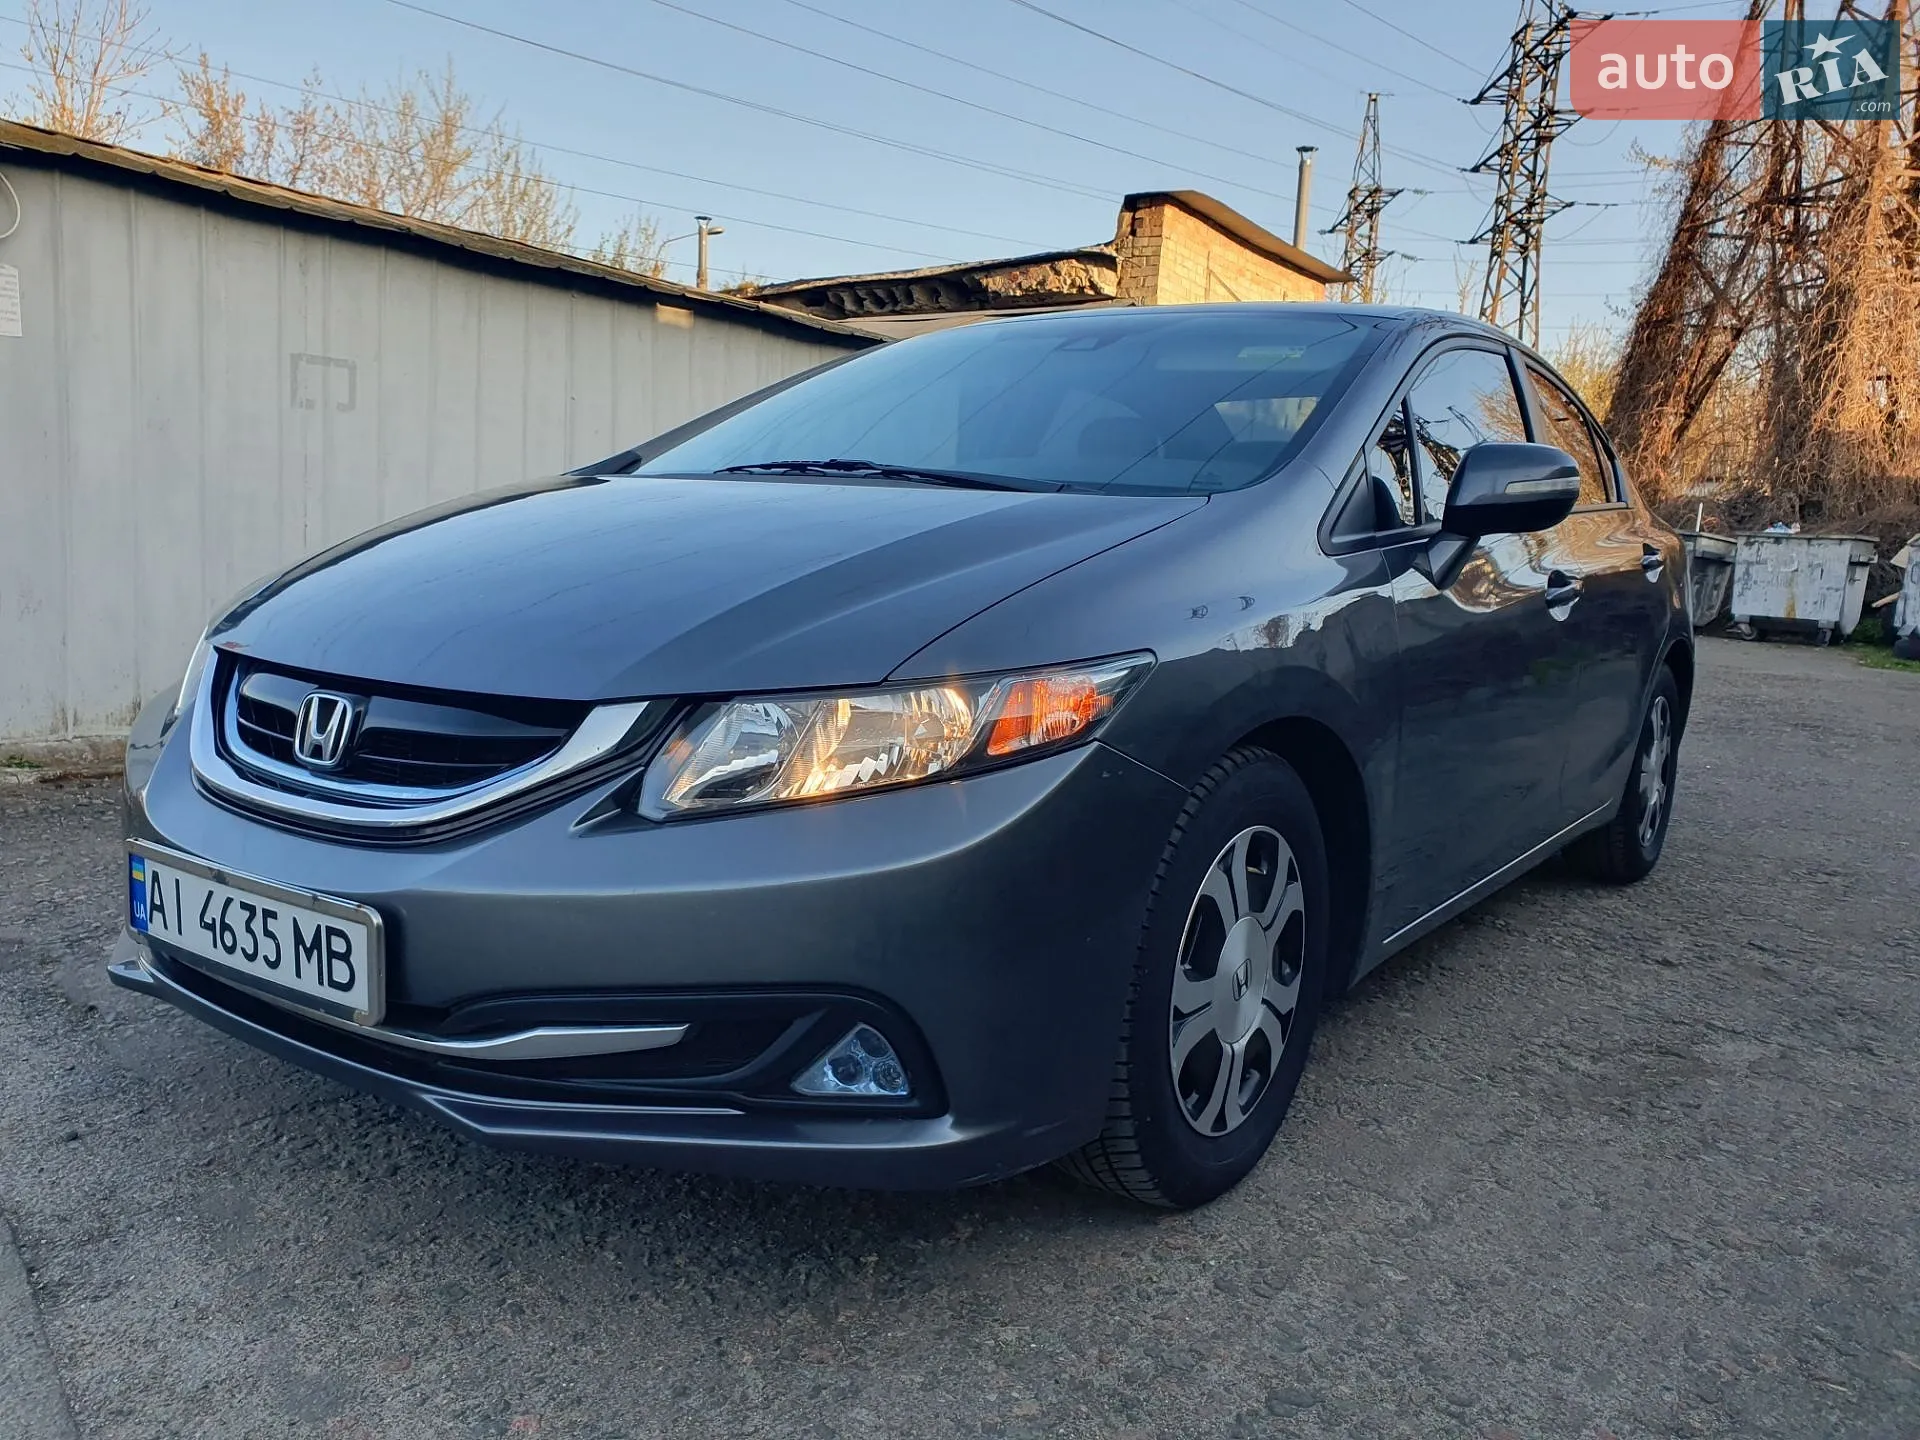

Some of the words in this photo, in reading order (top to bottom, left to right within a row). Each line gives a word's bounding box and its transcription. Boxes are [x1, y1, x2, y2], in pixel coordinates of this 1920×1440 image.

[134, 902, 147, 921] UA
[149, 870, 183, 936] AI
[199, 890, 282, 970] 4635
[292, 916, 356, 993] MB
